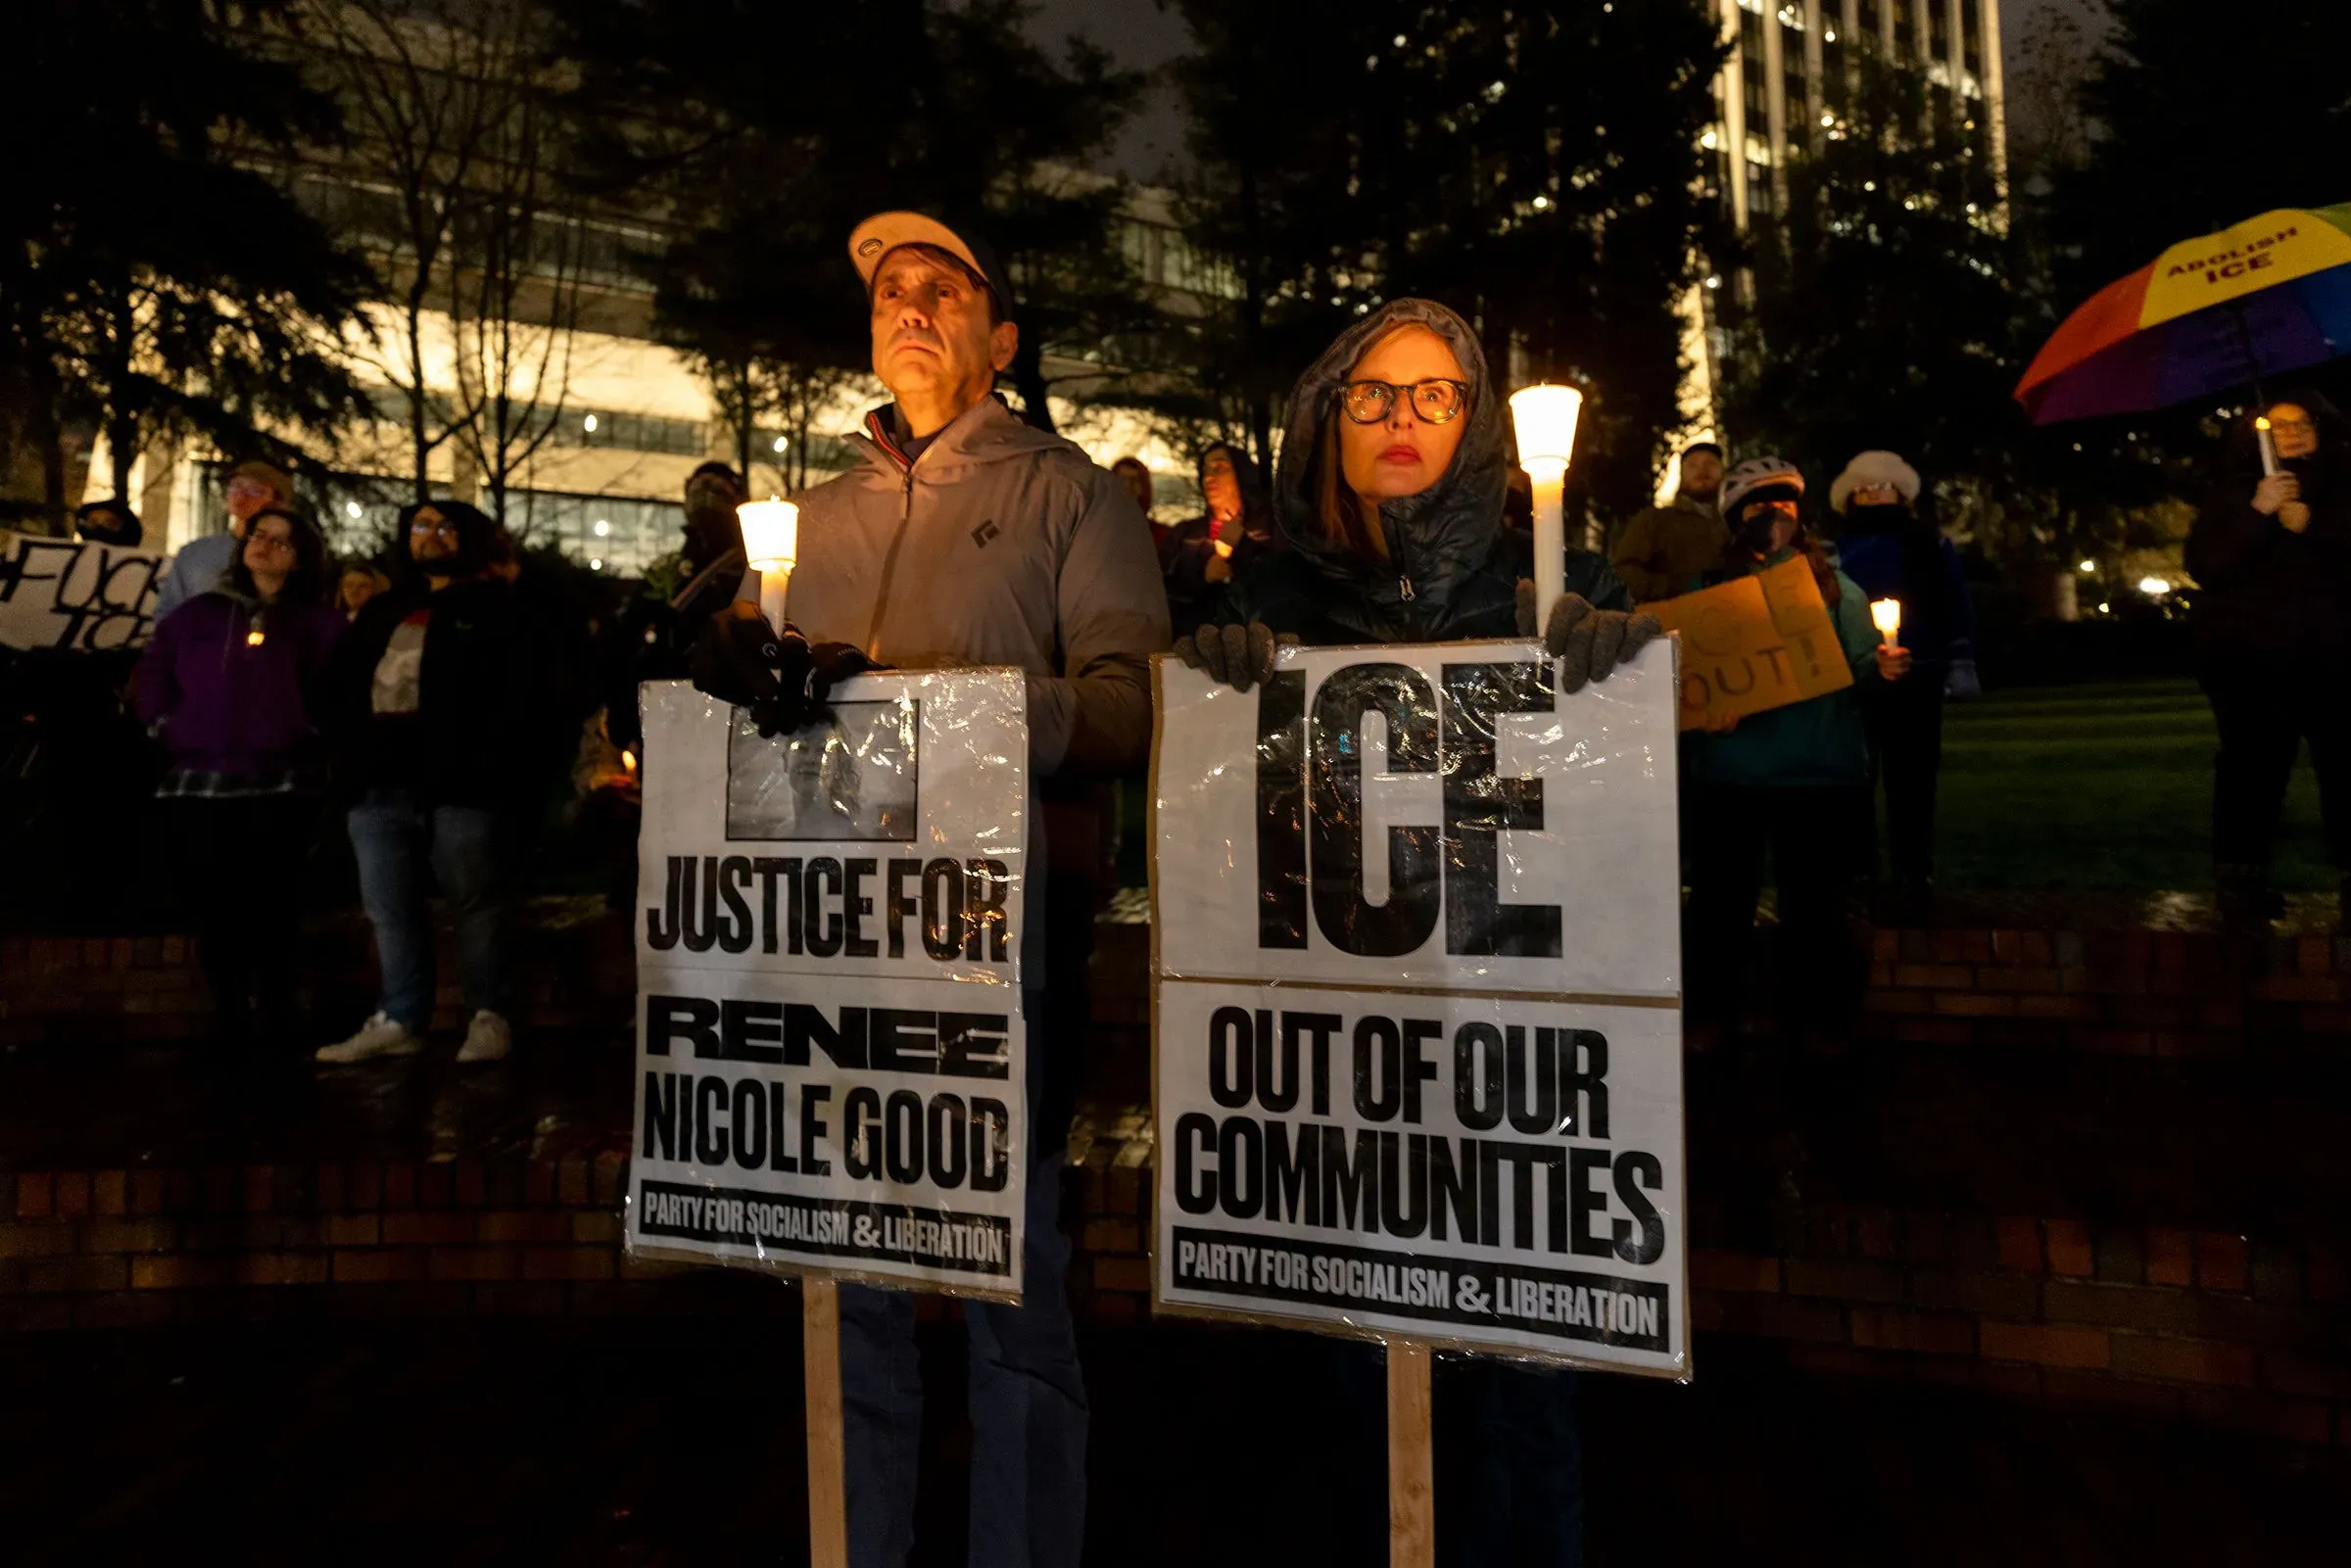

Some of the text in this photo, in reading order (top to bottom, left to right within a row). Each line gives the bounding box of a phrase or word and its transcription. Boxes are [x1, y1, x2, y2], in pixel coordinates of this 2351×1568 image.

[2166, 226, 2298, 278] ABOLISH
[2205, 251, 2275, 284] ICE
[1257, 661, 1564, 958] ICE
[647, 855, 1009, 963] JUSTICE FOR
[647, 994, 1009, 1080] RENEE
[1208, 1005, 1611, 1140] OUT OF OUR
[643, 1070, 1009, 1194] NICOLE GOOD
[645, 1191, 1004, 1264] PARTY FOR SOCIALISM & LIBERATION
[1175, 1112, 1665, 1266] COMMUNITIES
[1178, 1240, 1659, 1338] PARTY FOR SOCIALISM & LIBERATION
